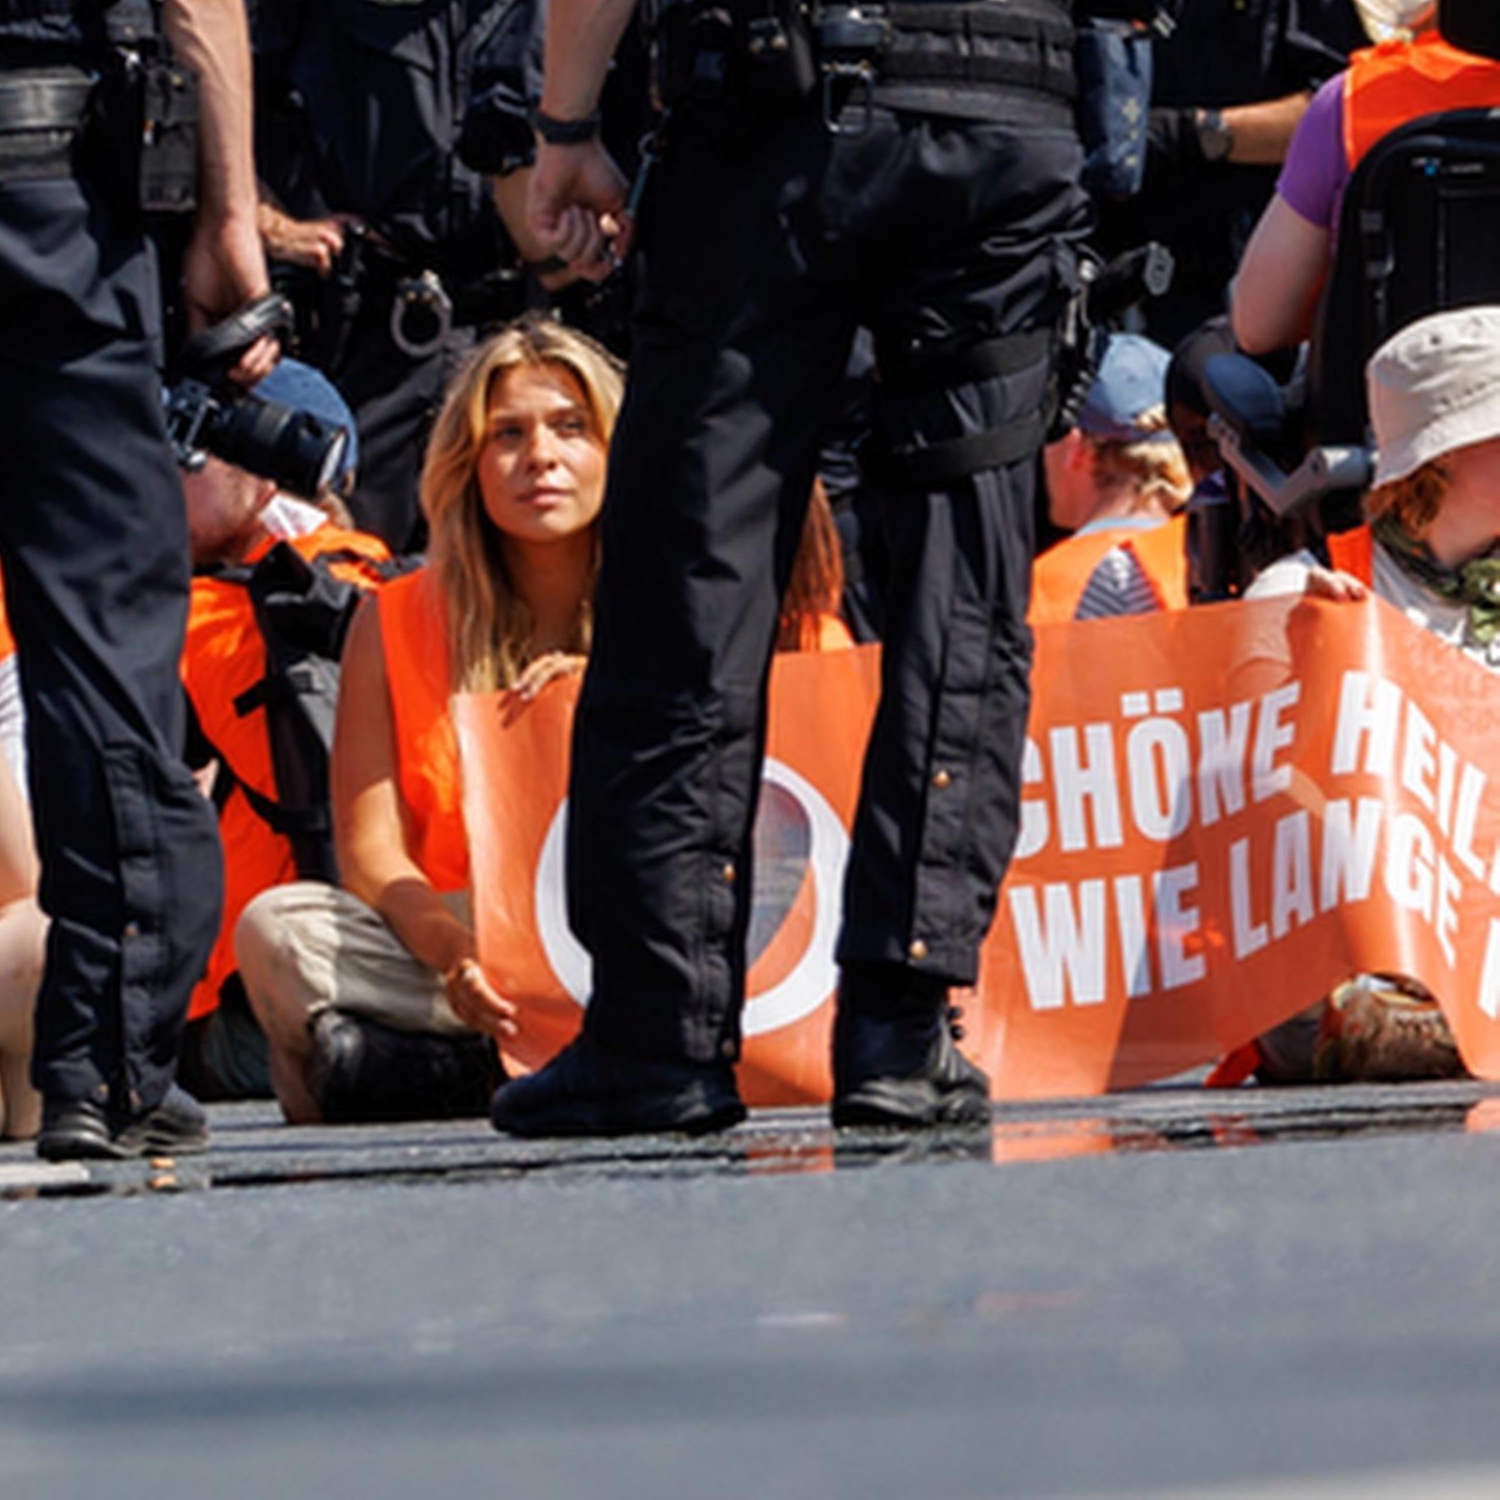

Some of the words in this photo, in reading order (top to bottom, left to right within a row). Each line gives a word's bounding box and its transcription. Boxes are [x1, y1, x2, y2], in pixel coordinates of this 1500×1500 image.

[1332, 670, 1500, 896] HEIL
[1008, 862, 1206, 1012] WIE
[1229, 797, 1462, 970] LANGE
